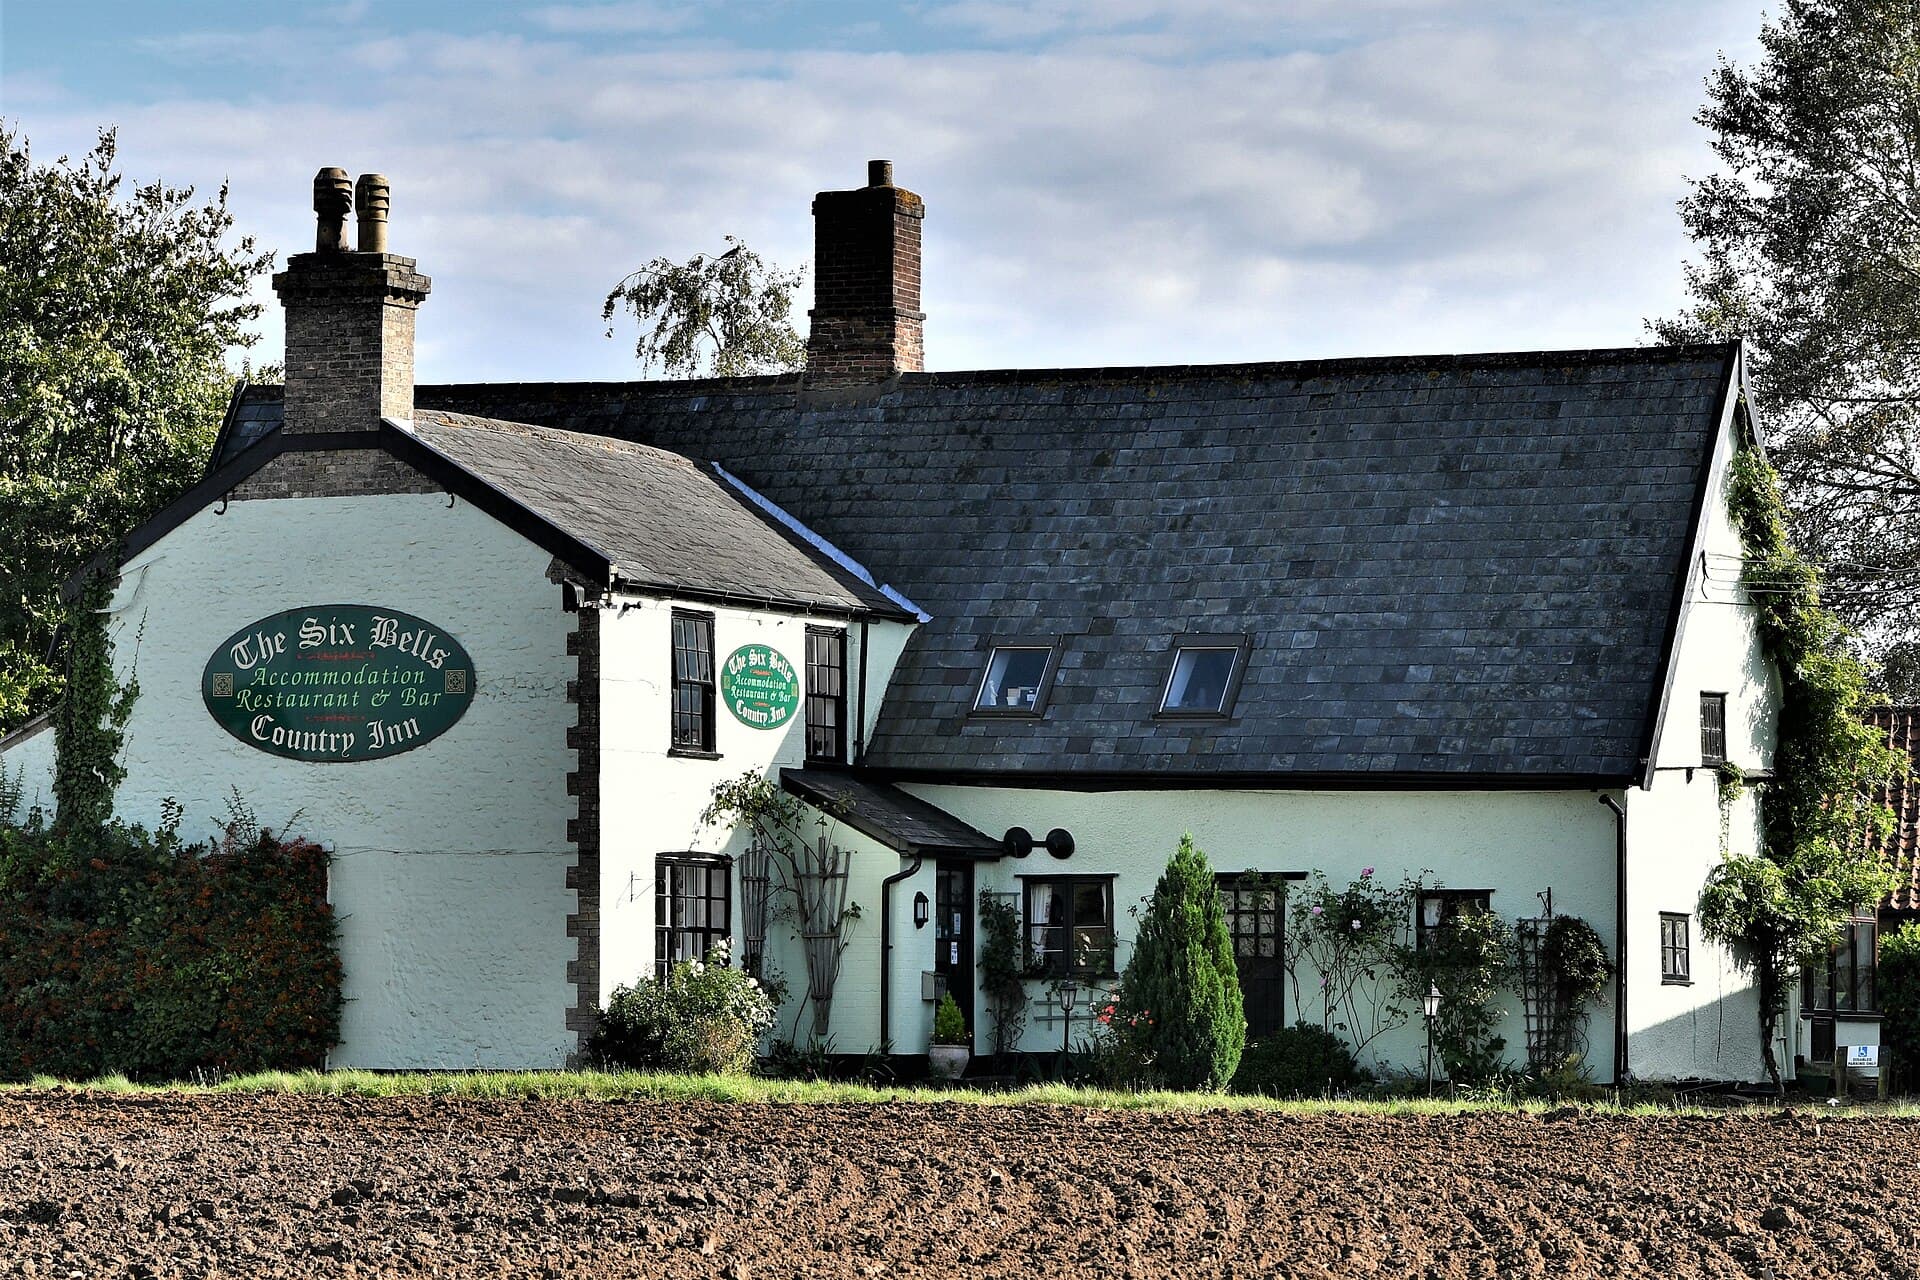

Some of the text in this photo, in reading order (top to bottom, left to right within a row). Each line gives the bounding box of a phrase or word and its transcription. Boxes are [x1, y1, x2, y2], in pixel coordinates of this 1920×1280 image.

[230, 615, 451, 670] The Six Bells
[250, 663, 426, 687] Accommodation
[728, 649, 793, 683] The Six Bells
[730, 685, 792, 703] Restaurant & Bar
[735, 674, 787, 690] Accommodation
[235, 688, 442, 712] Restaurant & Bar
[736, 699, 786, 727] Country Inn
[250, 714, 421, 757] Country Inn
